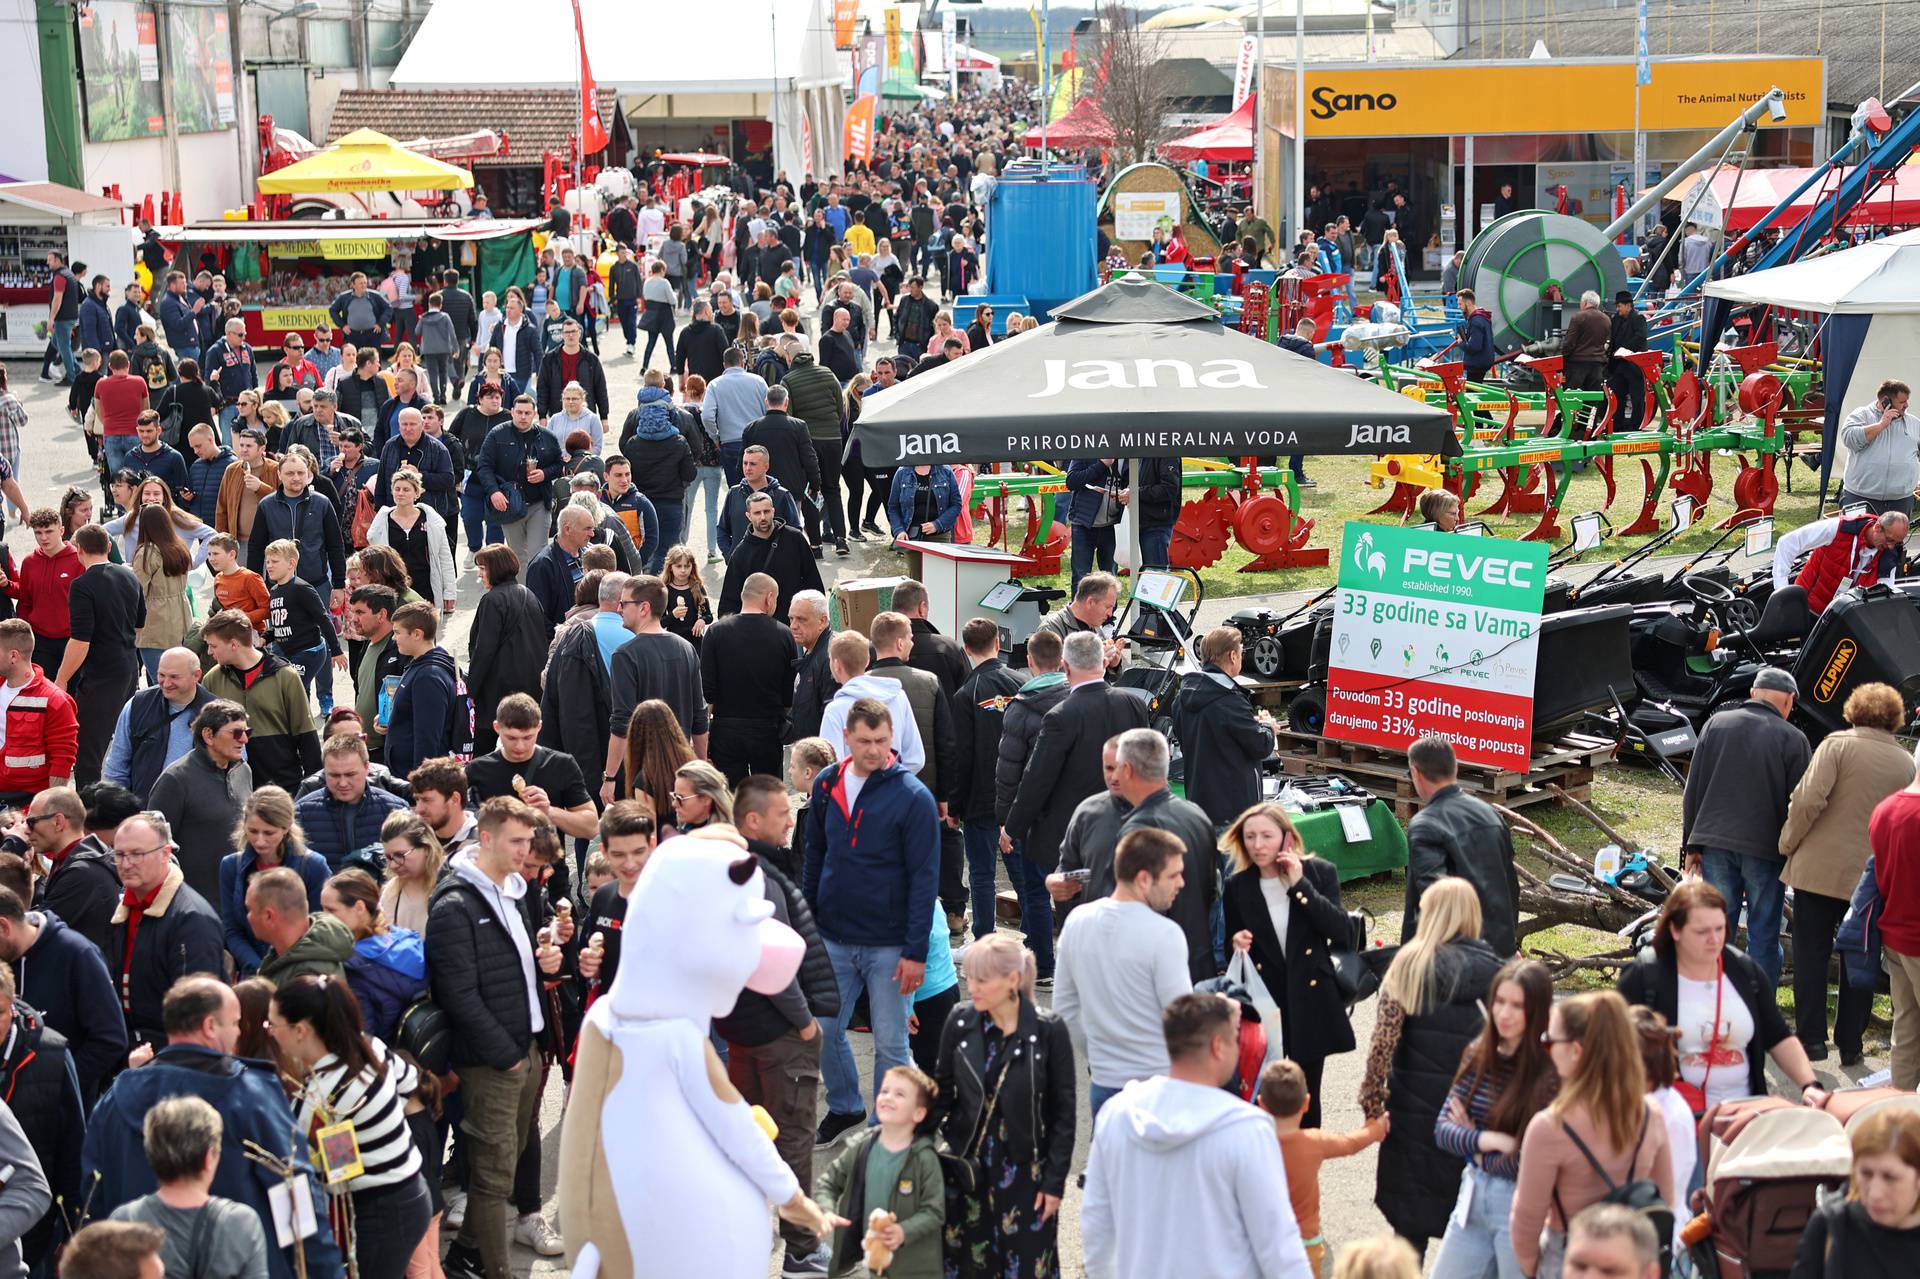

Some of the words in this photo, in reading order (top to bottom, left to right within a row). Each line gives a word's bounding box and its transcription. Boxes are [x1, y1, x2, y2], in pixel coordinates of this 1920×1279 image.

[1310, 87, 1397, 119] Sano
[1677, 95, 1697, 104] The
[1698, 93, 1736, 103] Animal
[334, 241, 385, 257] MEDENJACI
[278, 314, 327, 328] MEDENJACI
[1007, 434, 1110, 450] PRIRODNA
[1120, 432, 1235, 447] MINERALNA
[1244, 431, 1299, 445] VODA
[1403, 547, 1533, 588] PEVEC
[1402, 580, 1449, 594] established
[1451, 585, 1473, 597] 1990.
[1343, 593, 1367, 616] 33
[1373, 601, 1439, 626] godine
[1445, 611, 1467, 631] sa
[1474, 610, 1531, 639] Vama
[1429, 664, 1453, 674] PEVEC
[1460, 668, 1490, 680] PEVEC
[1821, 647, 1853, 698] ALPINA
[1333, 686, 1380, 705] Povodom
[1383, 690, 1404, 709] 33
[1408, 697, 1462, 718] godine
[1464, 708, 1525, 731] poslovanja
[1329, 712, 1378, 731] darujemo
[1381, 715, 1416, 737] 33%
[1479, 739, 1525, 756] popusta
